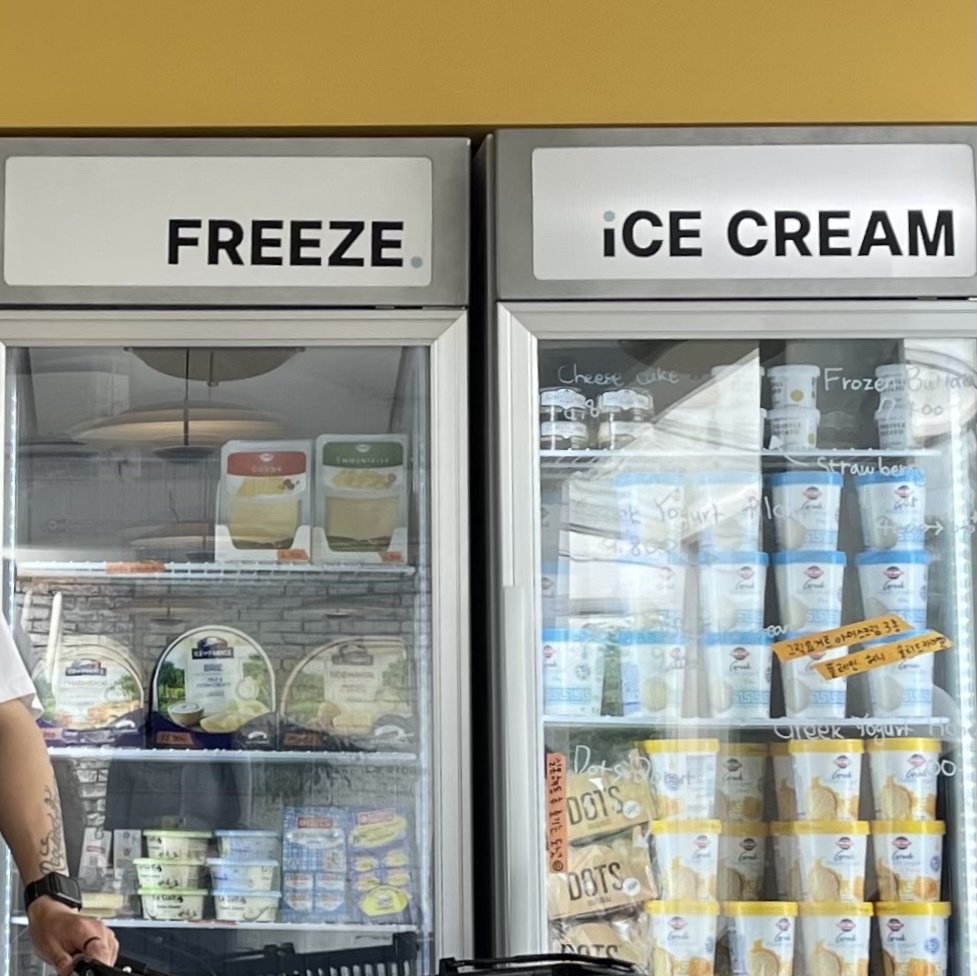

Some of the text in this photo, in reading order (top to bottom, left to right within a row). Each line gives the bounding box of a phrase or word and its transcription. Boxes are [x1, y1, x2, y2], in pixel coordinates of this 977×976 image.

[727, 210, 955, 257] CREAM
[558, 363, 623, 386] Cheese
[824, 367, 901, 392] Frozen
[566, 862, 624, 901] DOTS
